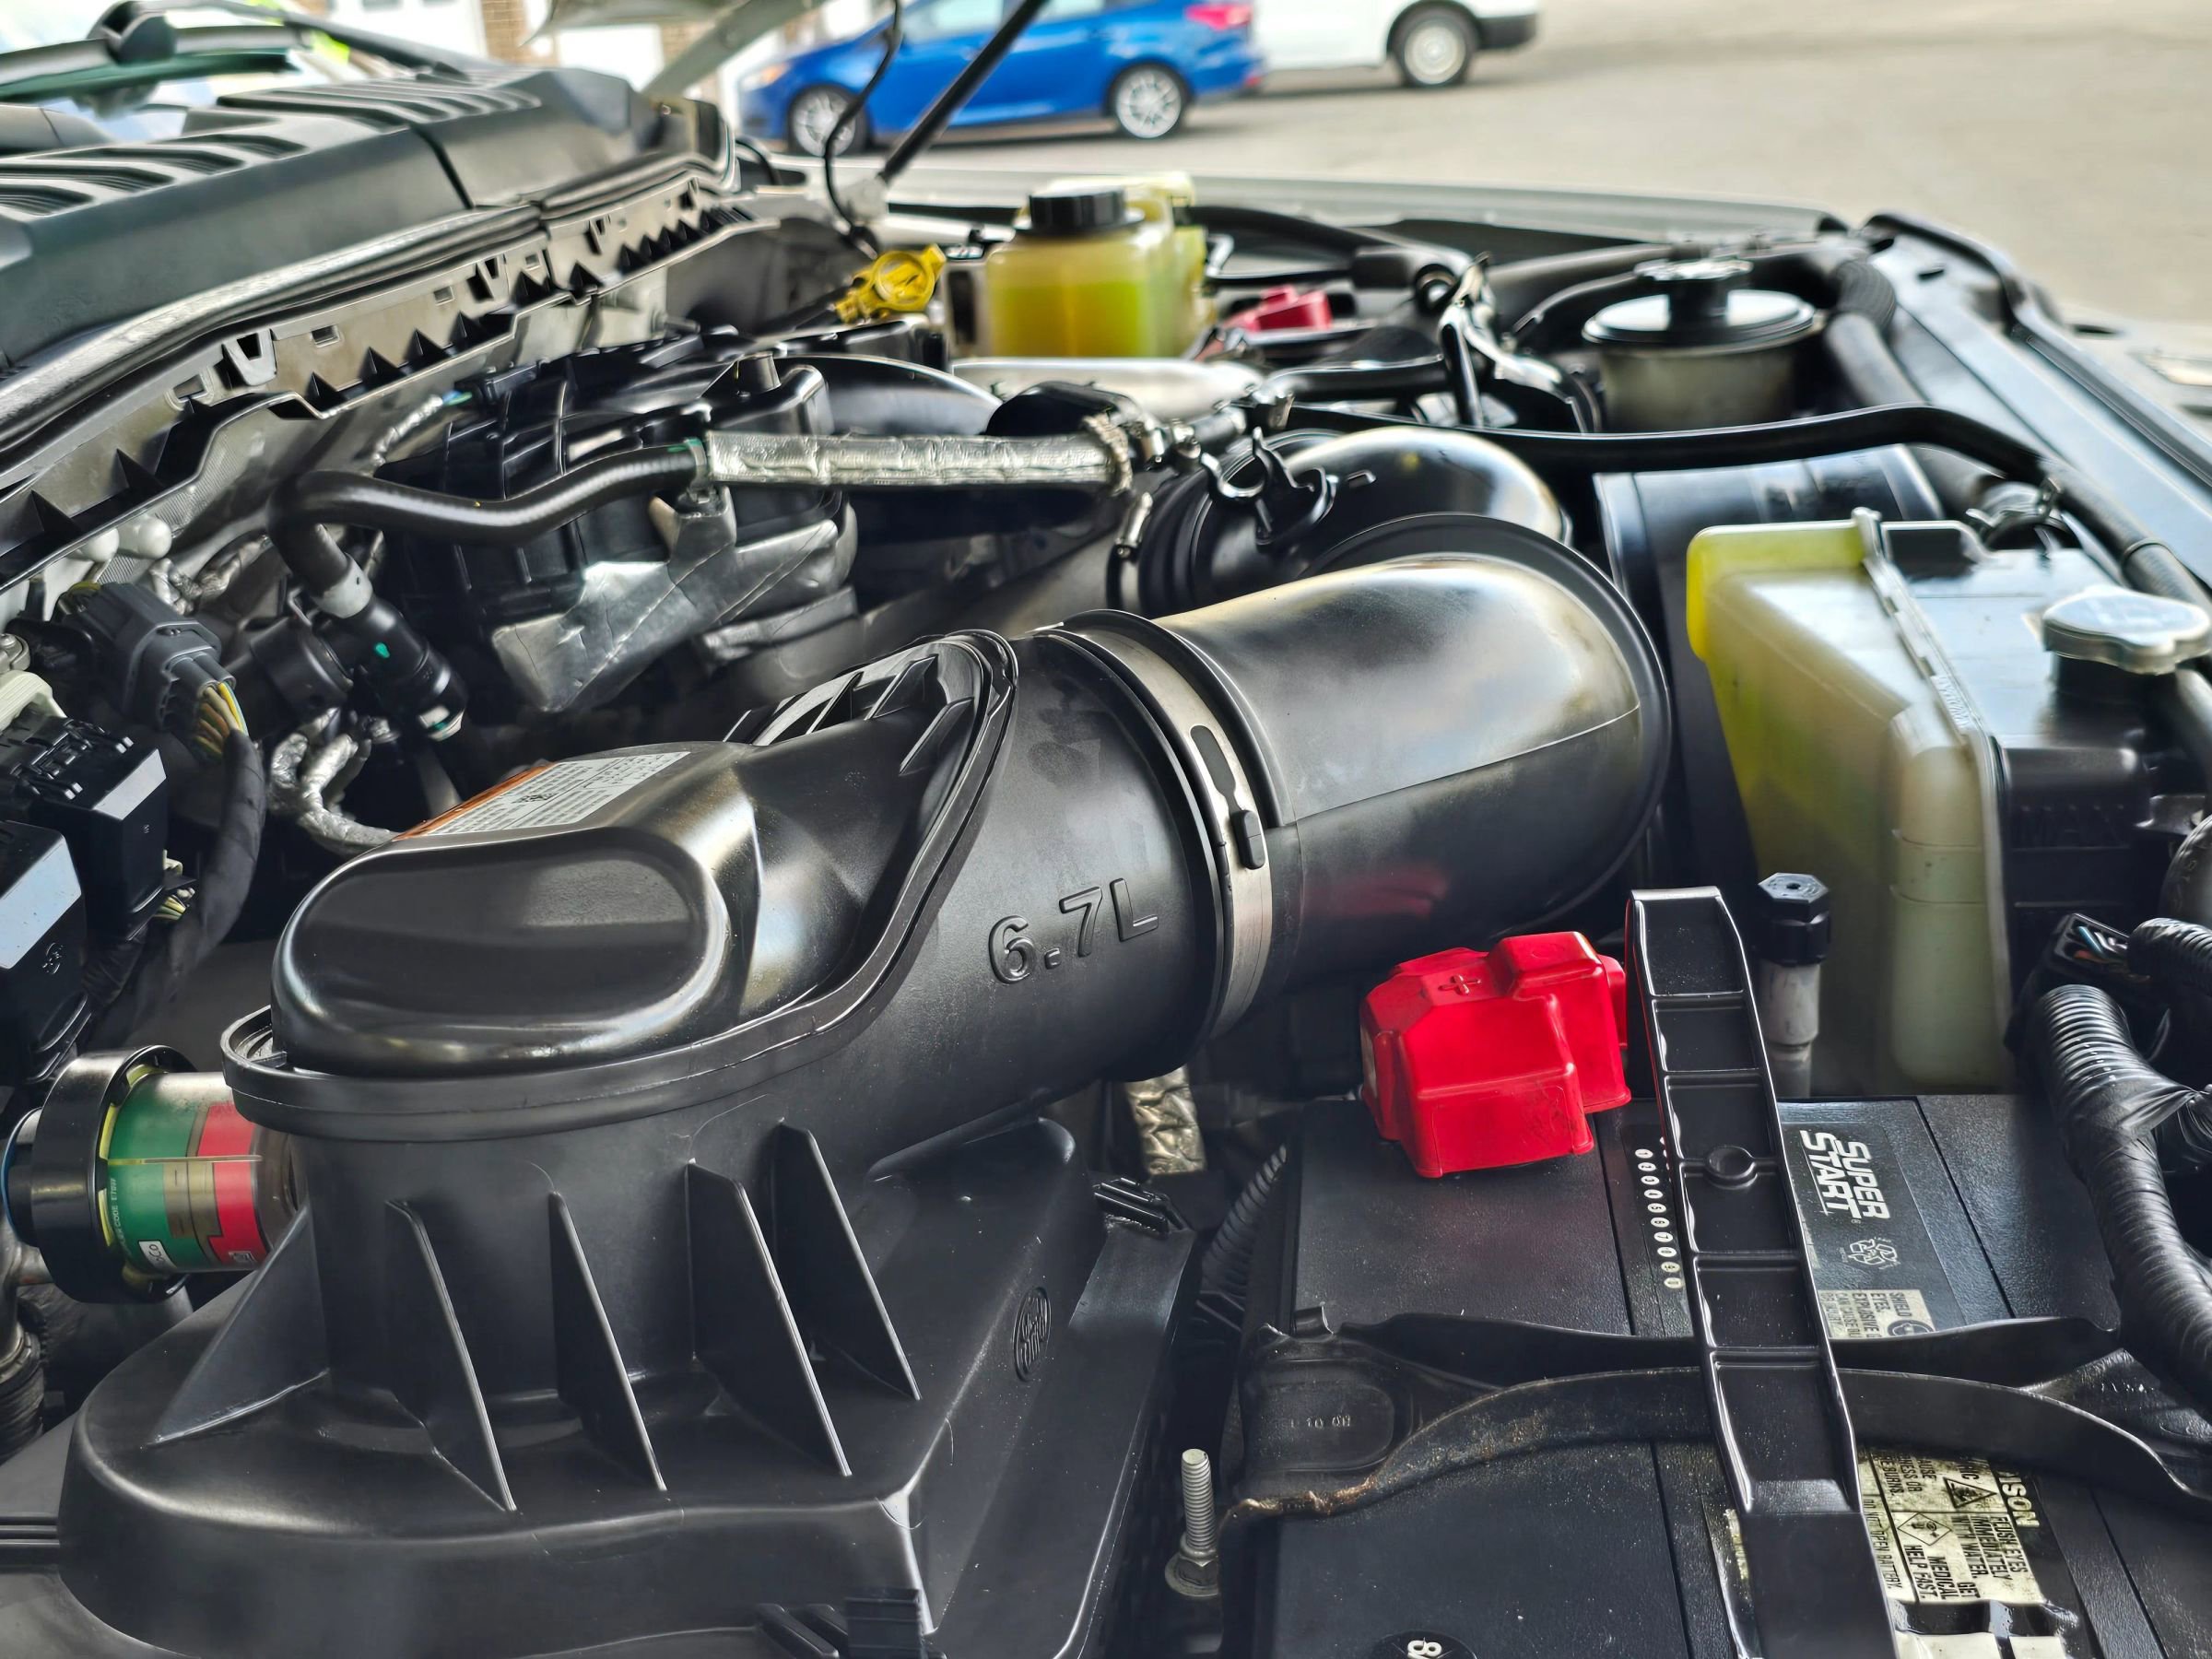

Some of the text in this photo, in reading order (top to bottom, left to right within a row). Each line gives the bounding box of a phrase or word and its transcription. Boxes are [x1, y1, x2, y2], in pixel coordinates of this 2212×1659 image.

[988, 878, 1159, 984] 6.7L
[1800, 1130, 1862, 1218] START
[1835, 1140, 1890, 1218] SUPER
[1852, 1293, 1879, 1332] EXPLOSIVE
[1888, 1292, 1912, 1317] SHIELD
[1883, 1467, 1905, 1497] BURNS.
[1899, 1459, 1924, 1492] NESS OR
[1916, 1459, 1937, 1481] AUSE
[1870, 1531, 1890, 1551] OPEN
[1951, 1516, 1990, 1579] WITH WATER.
[1971, 1516, 2013, 1580] IMMEDIATELY
[1990, 1516, 2029, 1572] FLUSH EYES
[1903, 1545, 1938, 1599] HELP FAST.
[1927, 1557, 1959, 1600] MEDICAL
[1957, 1582, 1982, 1598] GET
